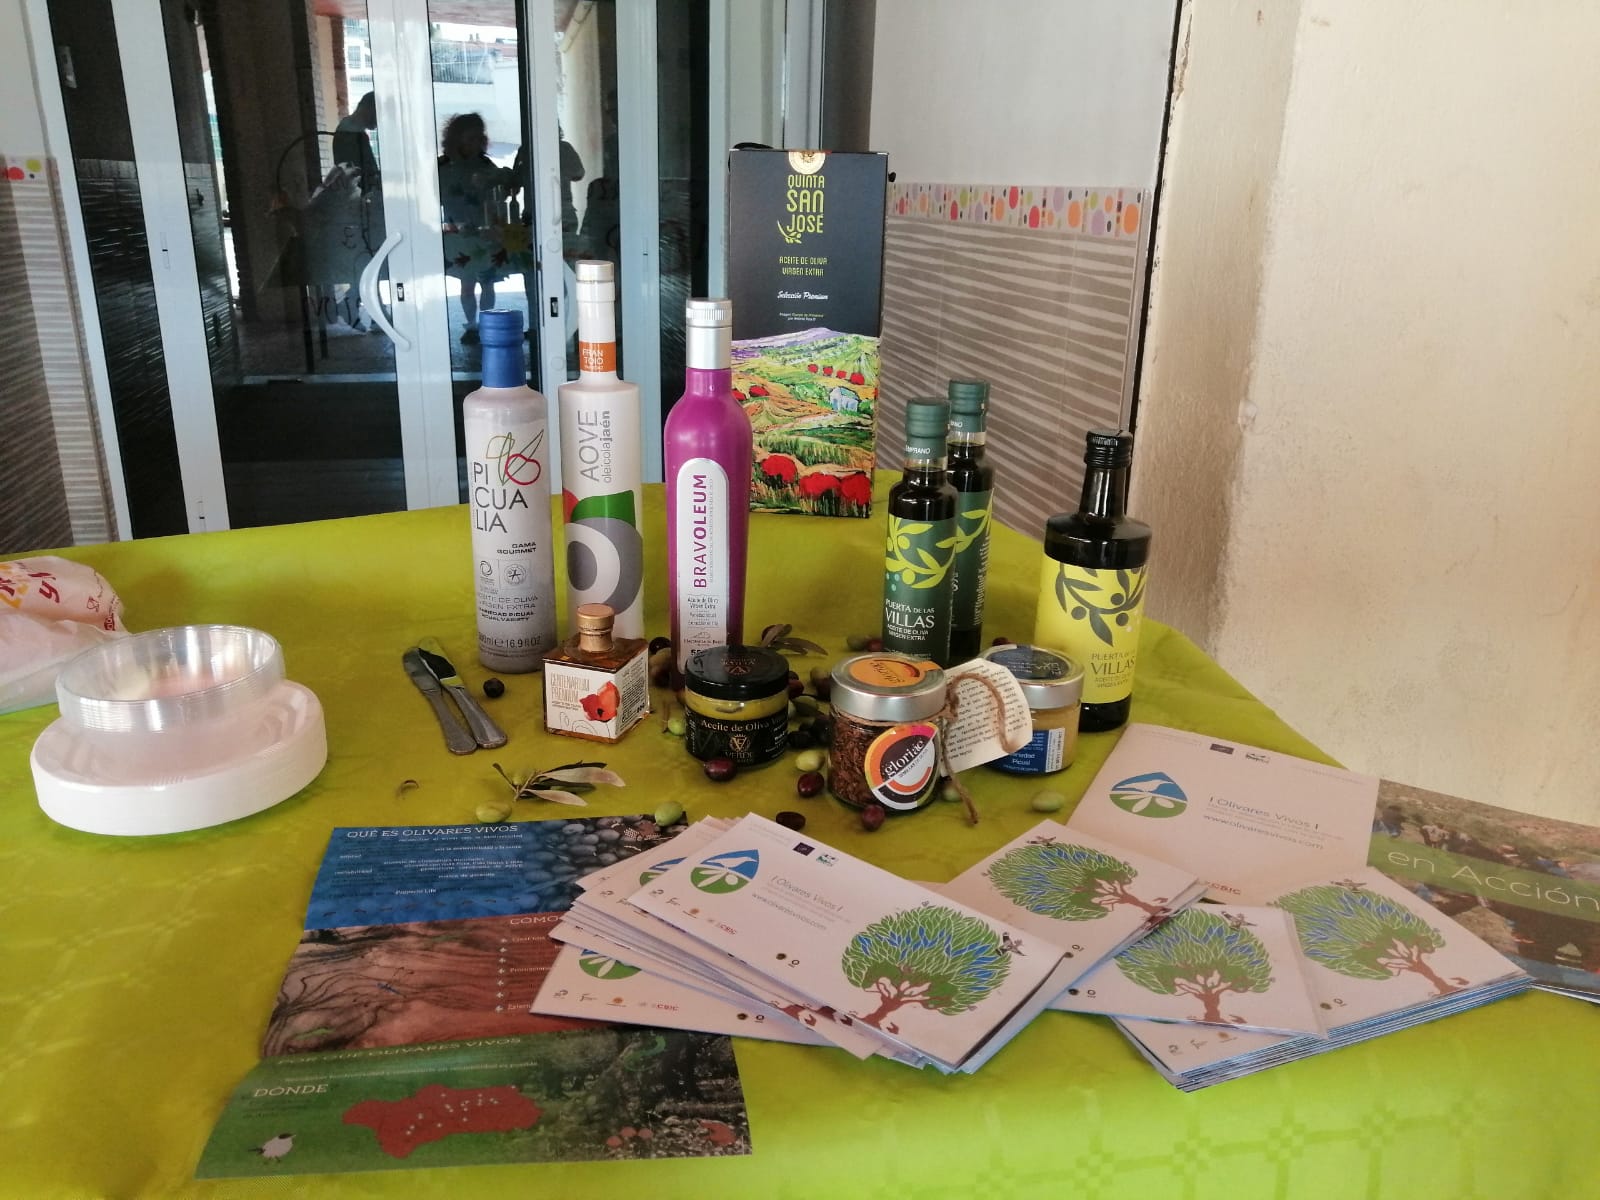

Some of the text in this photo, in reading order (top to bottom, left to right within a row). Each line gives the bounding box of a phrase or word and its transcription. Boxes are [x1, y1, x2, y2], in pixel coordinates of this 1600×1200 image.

[787, 175, 825, 188] QUINTA
[786, 190, 824, 213] SAN
[779, 256, 828, 265] ACEITE DE OLIVA
[782, 267, 804, 276] VIRGEN
[582, 349, 603, 357] FRAN
[577, 410, 599, 482] AOVE
[473, 461, 489, 485] PI
[474, 486, 528, 510] CUA
[475, 509, 508, 534] LIA
[693, 474, 707, 588] BRAVOLEUM
[513, 595, 538, 604] OLIVA
[885, 598, 912, 613] PUERTA
[885, 607, 936, 629] VILLAS
[701, 719, 769, 732] Aceite de Oliva
[1216, 797, 1310, 830] Olivares Vivos
[381, 829, 399, 837] ES
[402, 827, 472, 837] OLIVARES
[474, 825, 519, 834] VIVOS
[1386, 851, 1436, 874] en
[775, 877, 812, 900] Olivares
[1211, 882, 1242, 896] CSIC
[1451, 865, 1600, 912] Acción
[368, 1043, 461, 1056] OLIVARES
[465, 1037, 521, 1048] VIVOS
